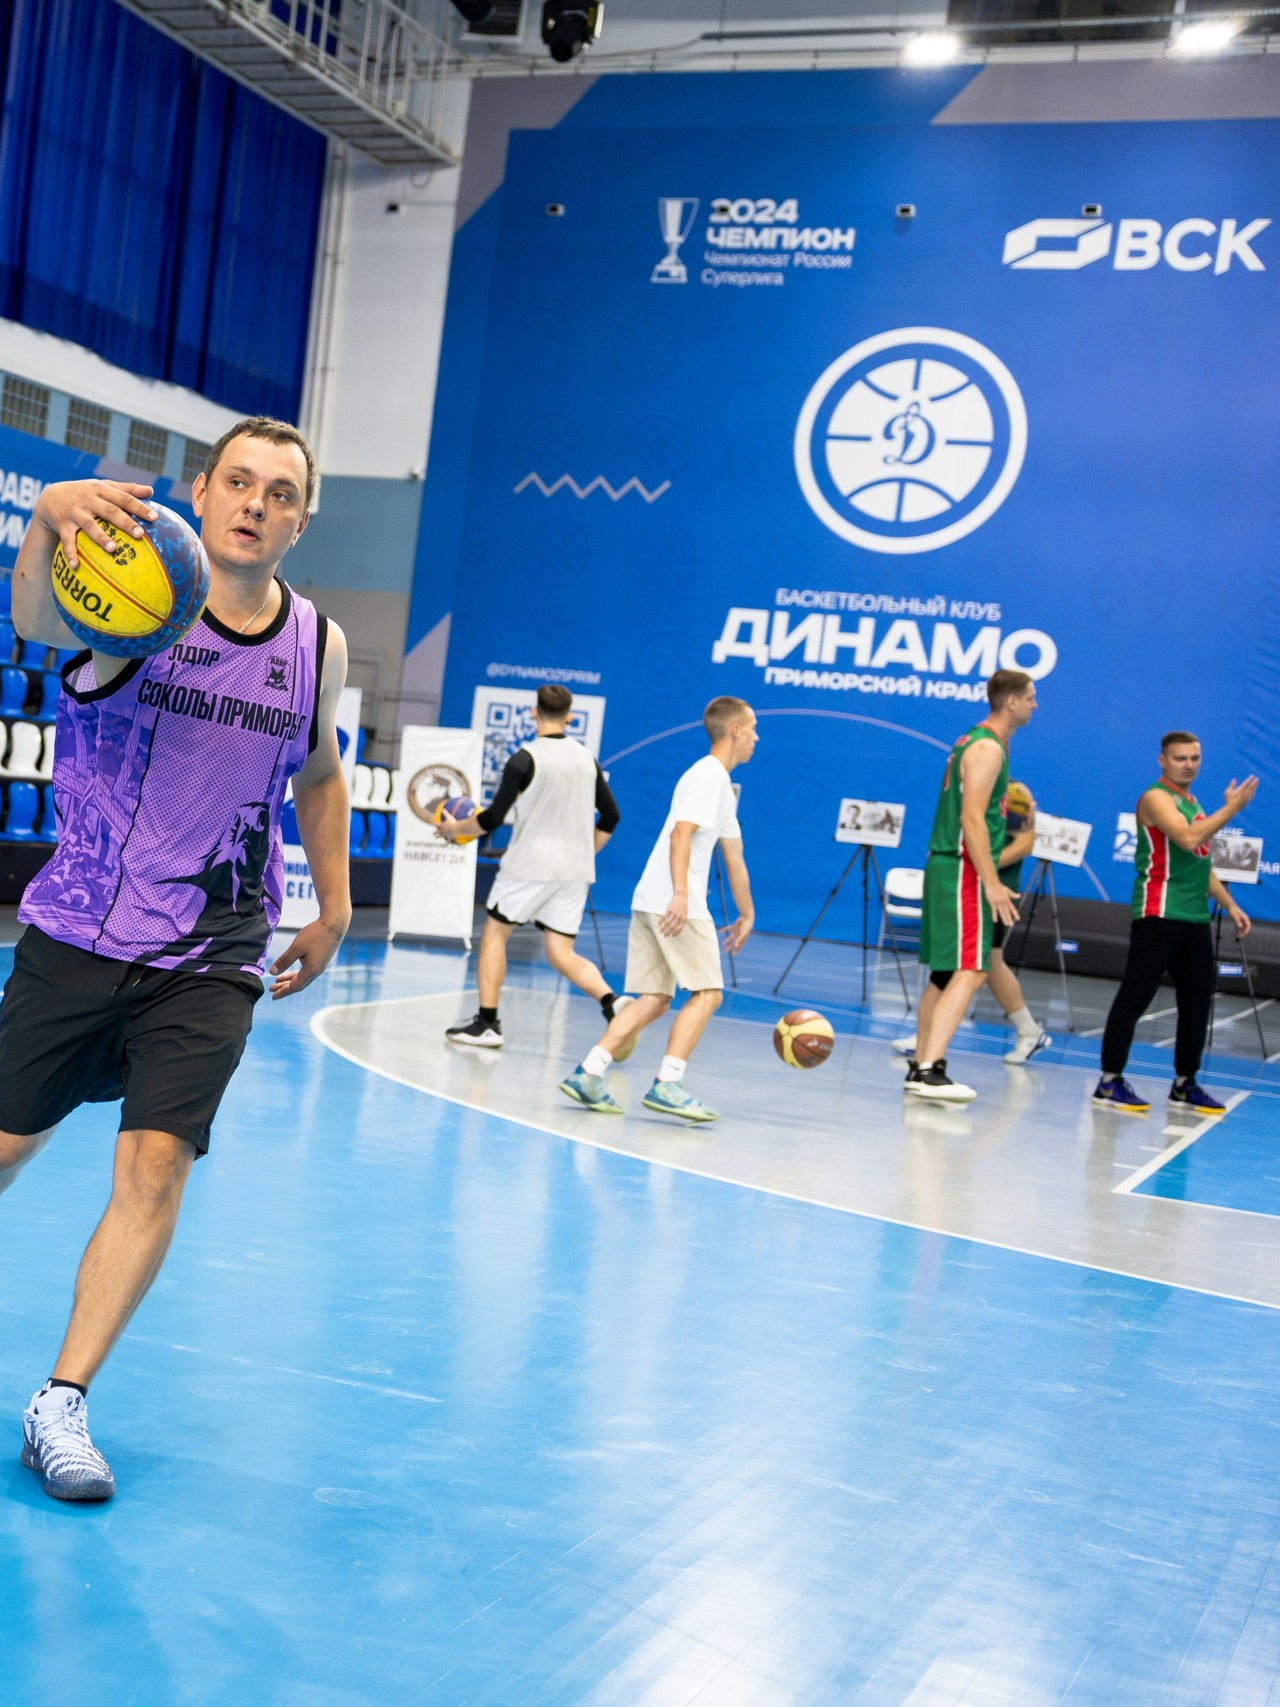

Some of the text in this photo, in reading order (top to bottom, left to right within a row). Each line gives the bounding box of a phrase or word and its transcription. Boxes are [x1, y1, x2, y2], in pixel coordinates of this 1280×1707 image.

[709, 198, 799, 224] 2024
[706, 227, 856, 250] ЧЕМПИОН
[1113, 218, 1272, 276] ВСК
[704, 251, 853, 269] Чемпионат России
[700, 268, 784, 287] Суперлига
[52, 550, 114, 622] TORRES
[775, 588, 1002, 621] БАСКЕТБОЛЬНЫЙ КЛУБ
[168, 644, 220, 667] ЛДПР
[711, 607, 1058, 681] ДИНАМО
[764, 667, 921, 697] ПРИМОРСКИЙ
[137, 678, 217, 721] СОКОЛЫ
